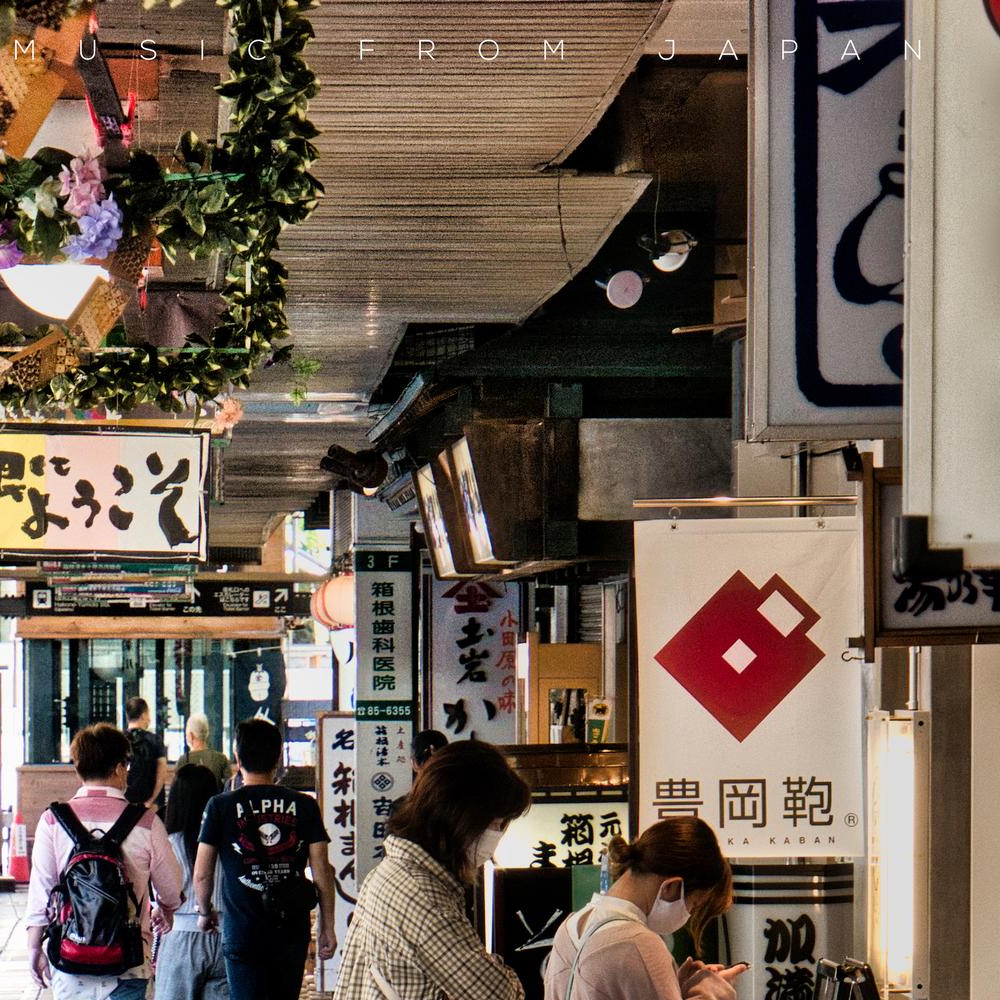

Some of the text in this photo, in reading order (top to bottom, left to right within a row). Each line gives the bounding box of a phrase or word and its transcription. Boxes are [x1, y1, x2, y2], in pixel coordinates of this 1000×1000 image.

[371, 581, 396, 692] 箱根歯科医院
[496, 610, 518, 714] 小田原の味
[367, 706, 411, 716] 85-6355
[375, 725, 390, 767] 箱根湯本
[236, 799, 297, 818] ALPHA
[652, 776, 834, 829] 豊岡鞄
[769, 836, 835, 845] KABAN
